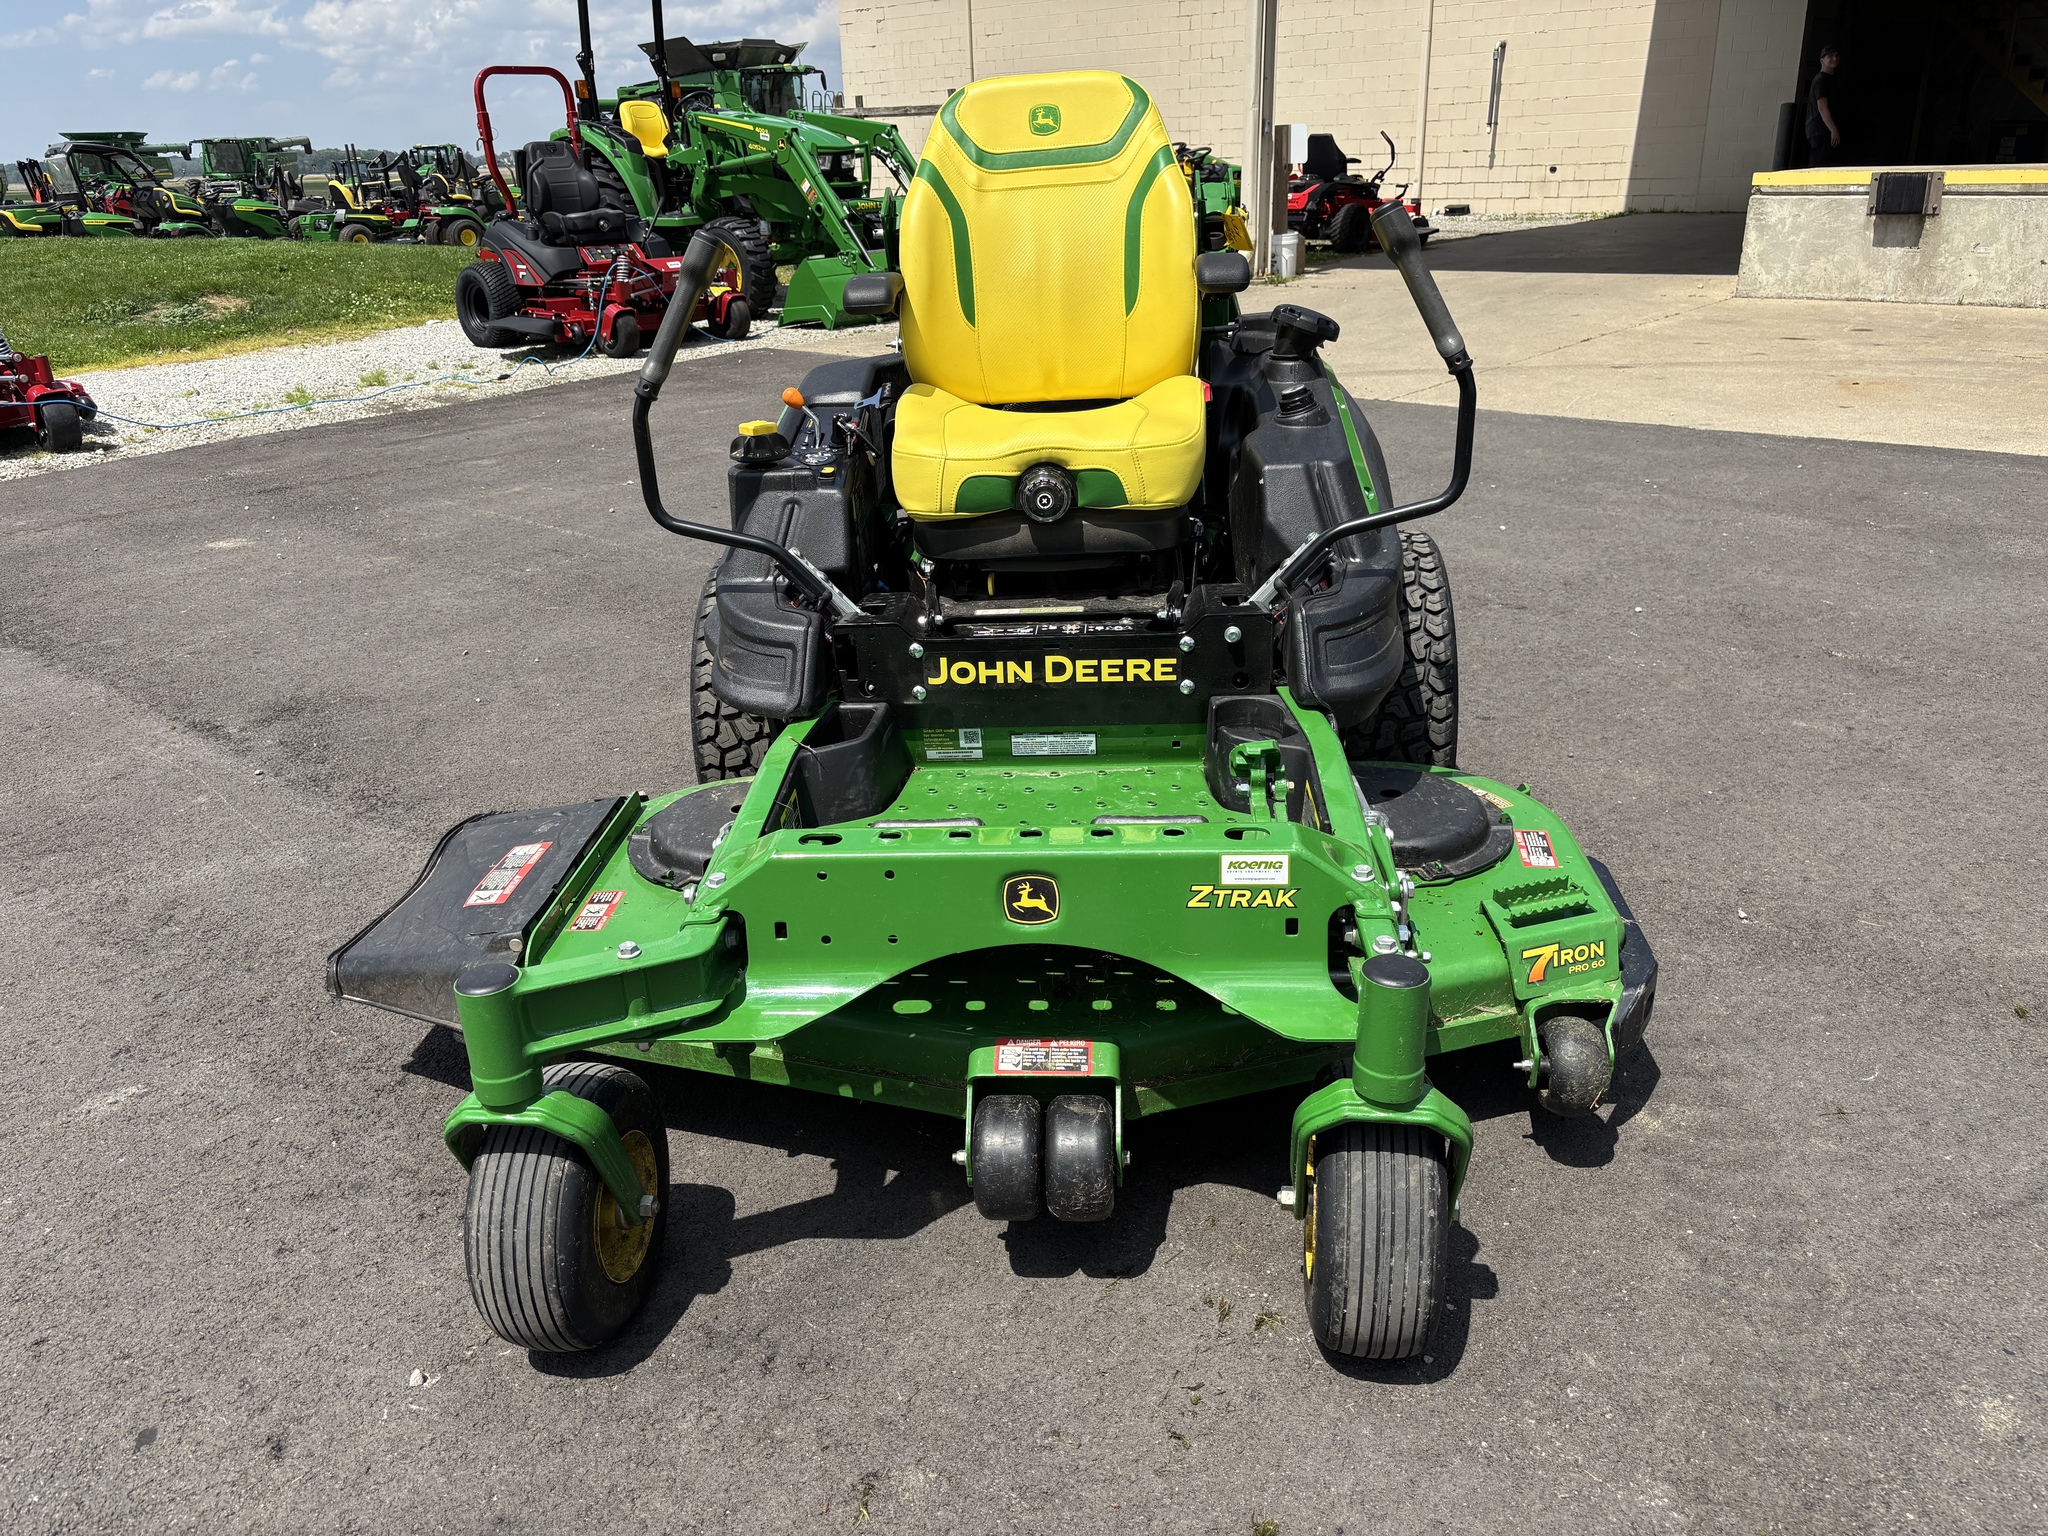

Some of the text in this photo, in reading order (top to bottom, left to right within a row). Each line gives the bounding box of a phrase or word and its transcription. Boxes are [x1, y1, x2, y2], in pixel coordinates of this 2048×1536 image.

[856, 202, 876, 210] JOHN
[927, 655, 1178, 685] JOHN DEERE
[1186, 885, 1300, 908] ZTRAK
[1568, 959, 1606, 975] PRO 60
